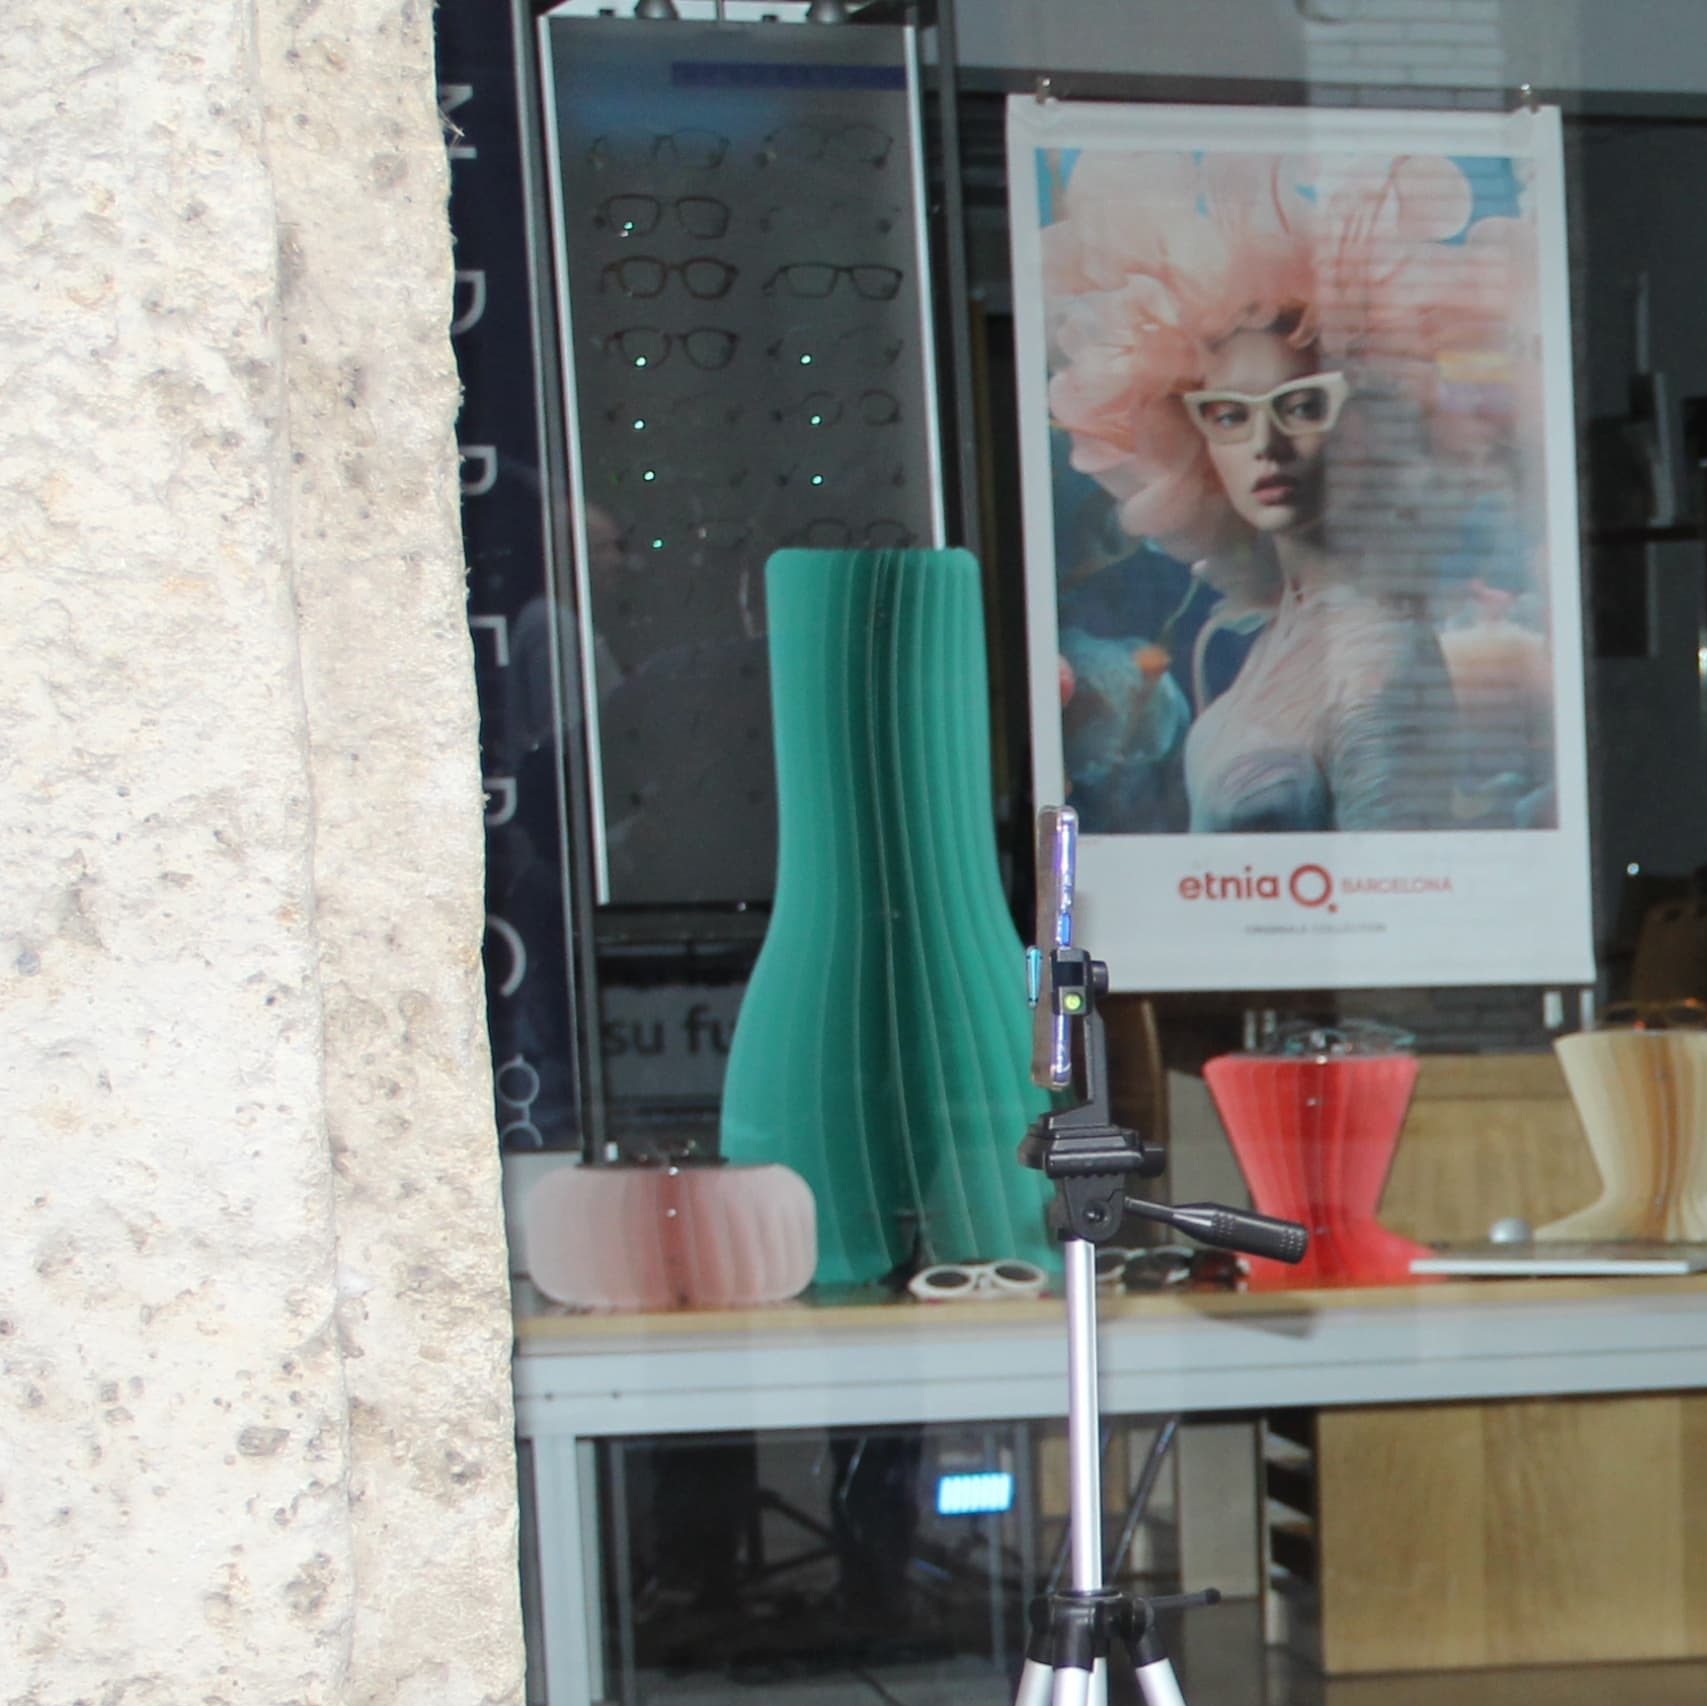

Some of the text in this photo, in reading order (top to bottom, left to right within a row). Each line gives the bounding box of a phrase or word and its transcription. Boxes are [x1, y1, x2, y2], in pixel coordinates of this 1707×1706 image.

[1178, 865, 1453, 900] etnia BARCELONA
[685, 1004, 735, 1056] fu
